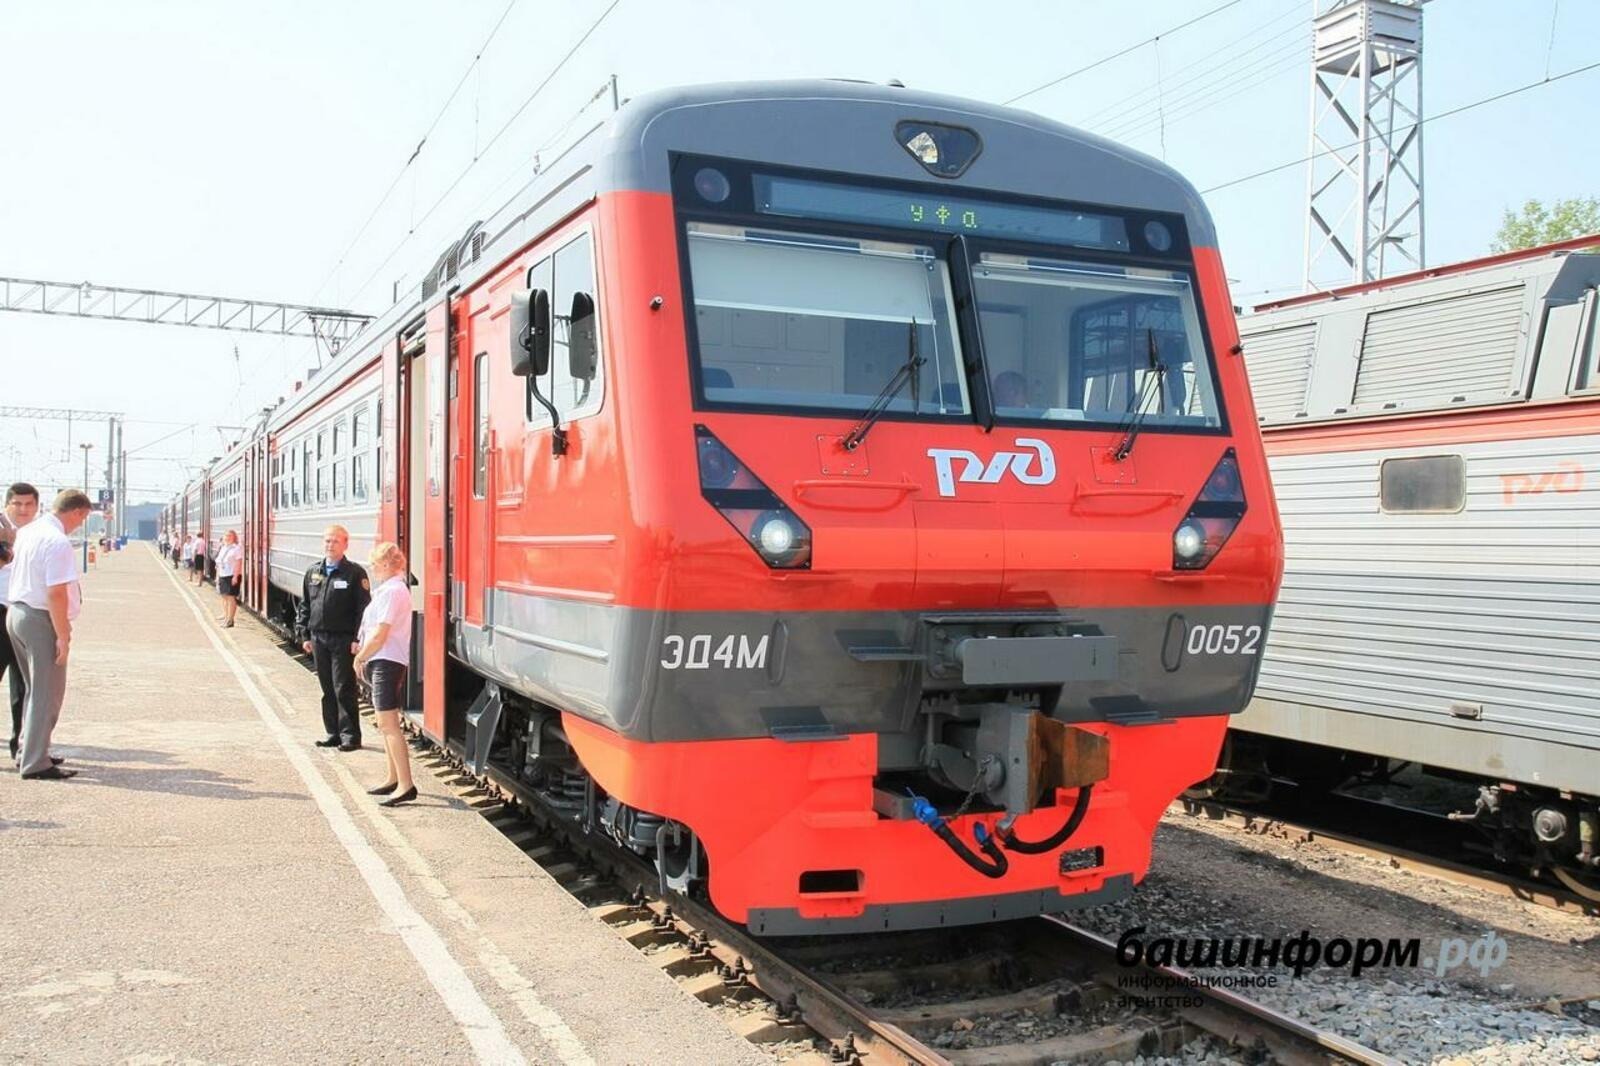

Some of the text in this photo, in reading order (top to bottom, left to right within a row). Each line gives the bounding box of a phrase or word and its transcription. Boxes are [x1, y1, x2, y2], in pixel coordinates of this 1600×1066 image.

[927, 437, 1057, 497] РЖД
[1499, 461, 1585, 505] РЖД
[660, 634, 769, 670] ЭД4М
[1187, 625, 1262, 655] 0052
